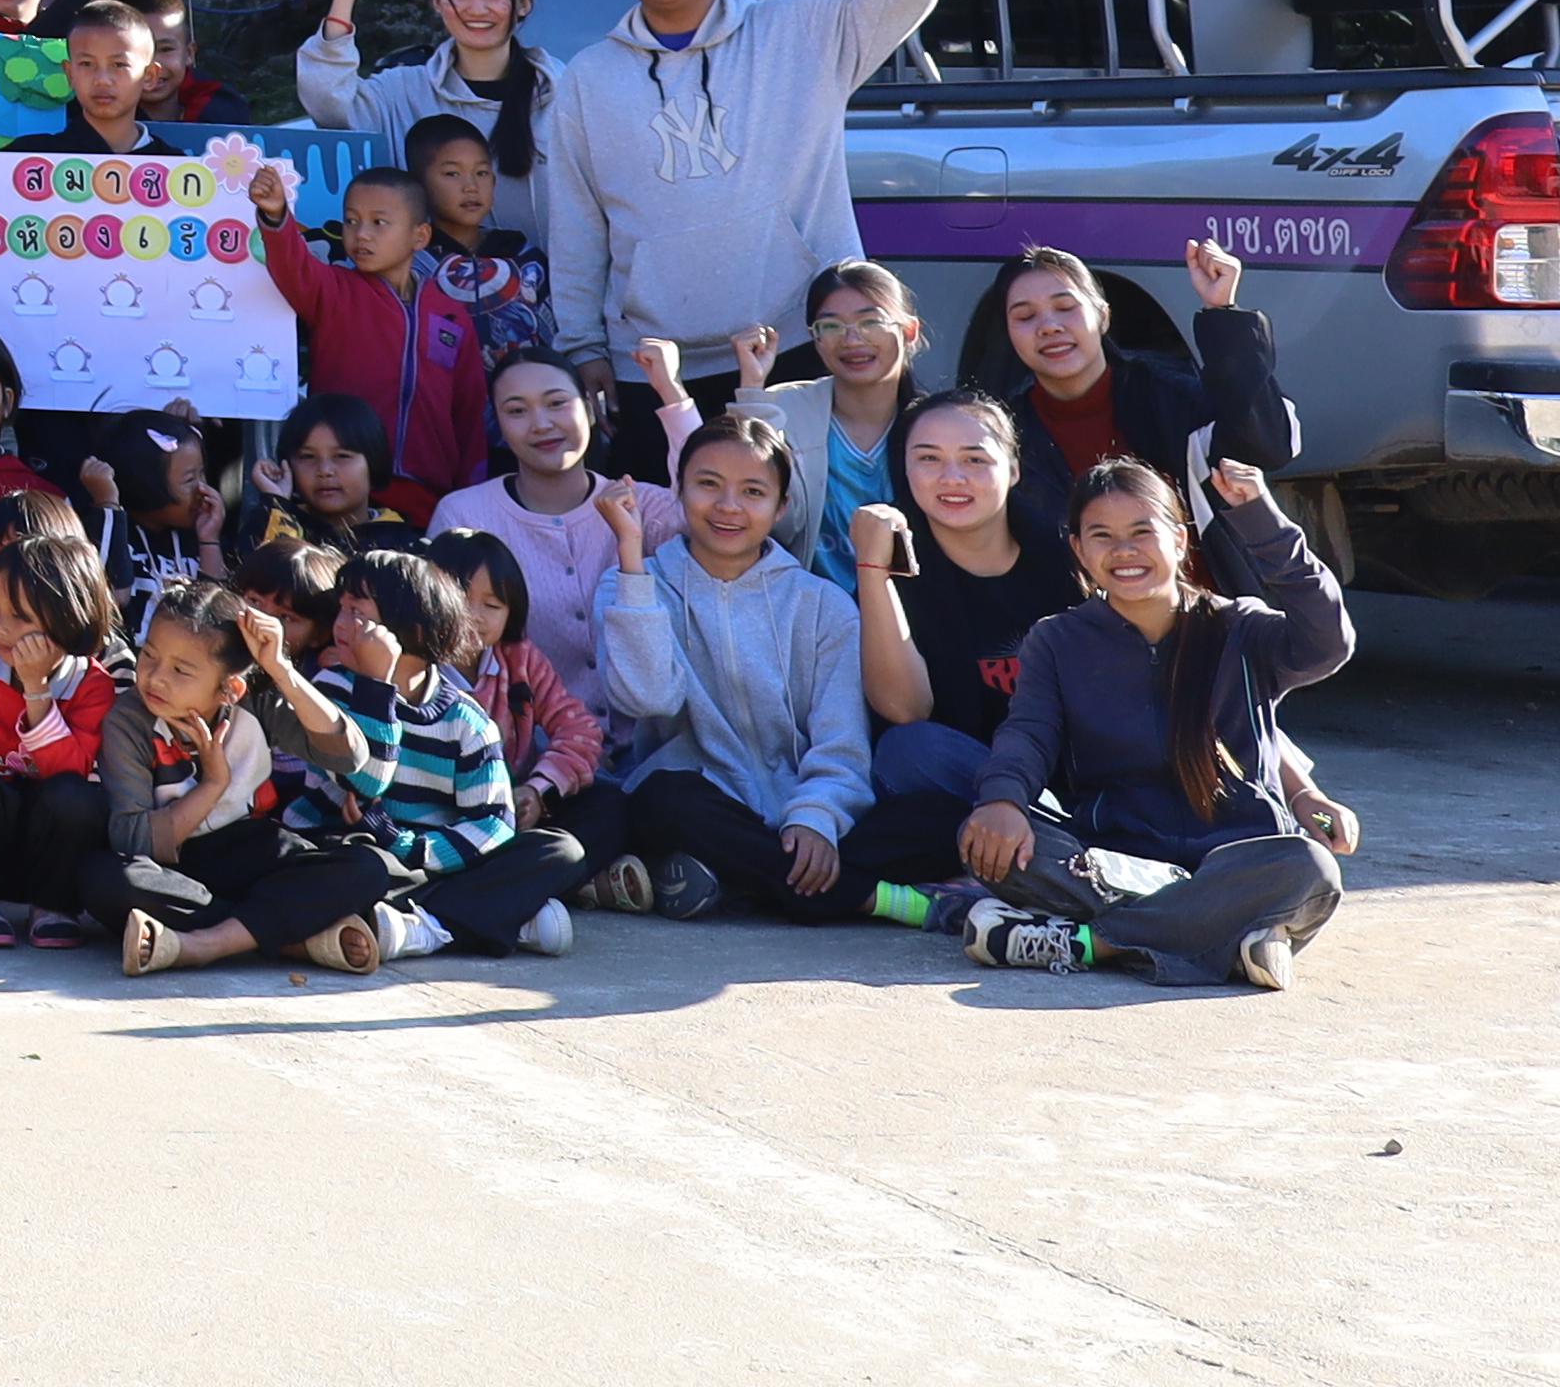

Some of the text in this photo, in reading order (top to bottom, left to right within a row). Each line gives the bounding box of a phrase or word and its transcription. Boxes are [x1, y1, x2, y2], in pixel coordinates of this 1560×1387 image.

[1272, 131, 1406, 172] 4x4
[24, 169, 202, 199] สมาชิก
[1329, 168, 1394, 177] DIFF LOCK
[1206, 216, 1361, 256] บช.ตชด.
